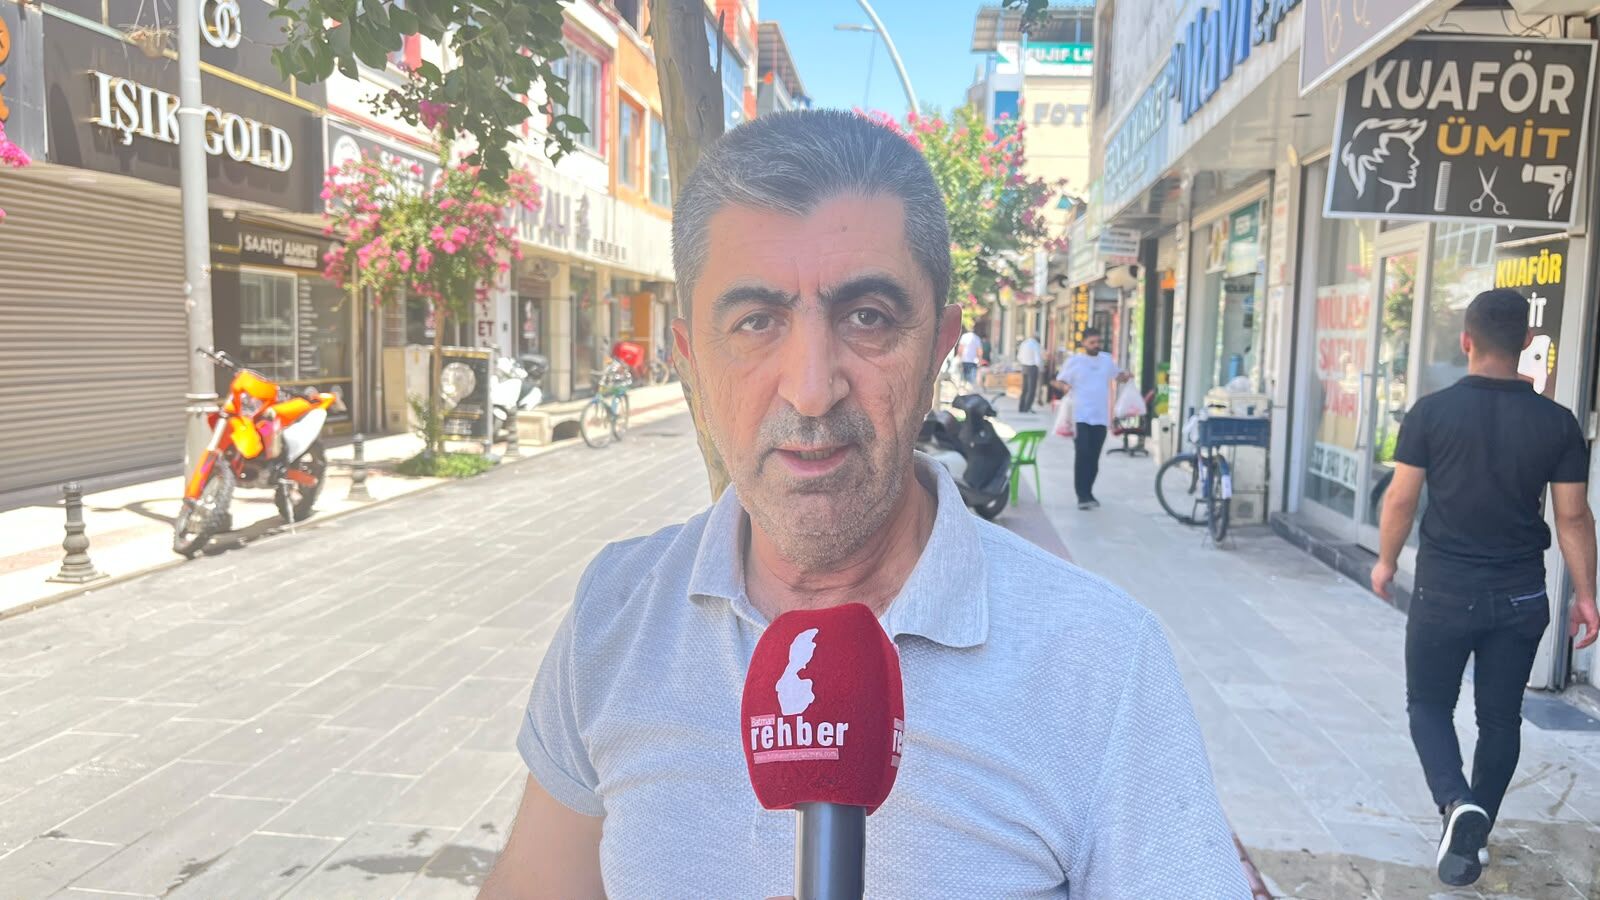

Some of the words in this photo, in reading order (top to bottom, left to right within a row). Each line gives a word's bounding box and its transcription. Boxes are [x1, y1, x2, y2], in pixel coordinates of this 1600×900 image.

[1361, 50, 1576, 114] KUAFÖR
[96, 71, 181, 146] IŞIK
[201, 104, 293, 172] GOLD
[1437, 117, 1570, 159] ÜMİT
[1496, 249, 1562, 289] KUAFÖR
[1527, 292, 1547, 328] İT
[751, 716, 849, 751] rehber
